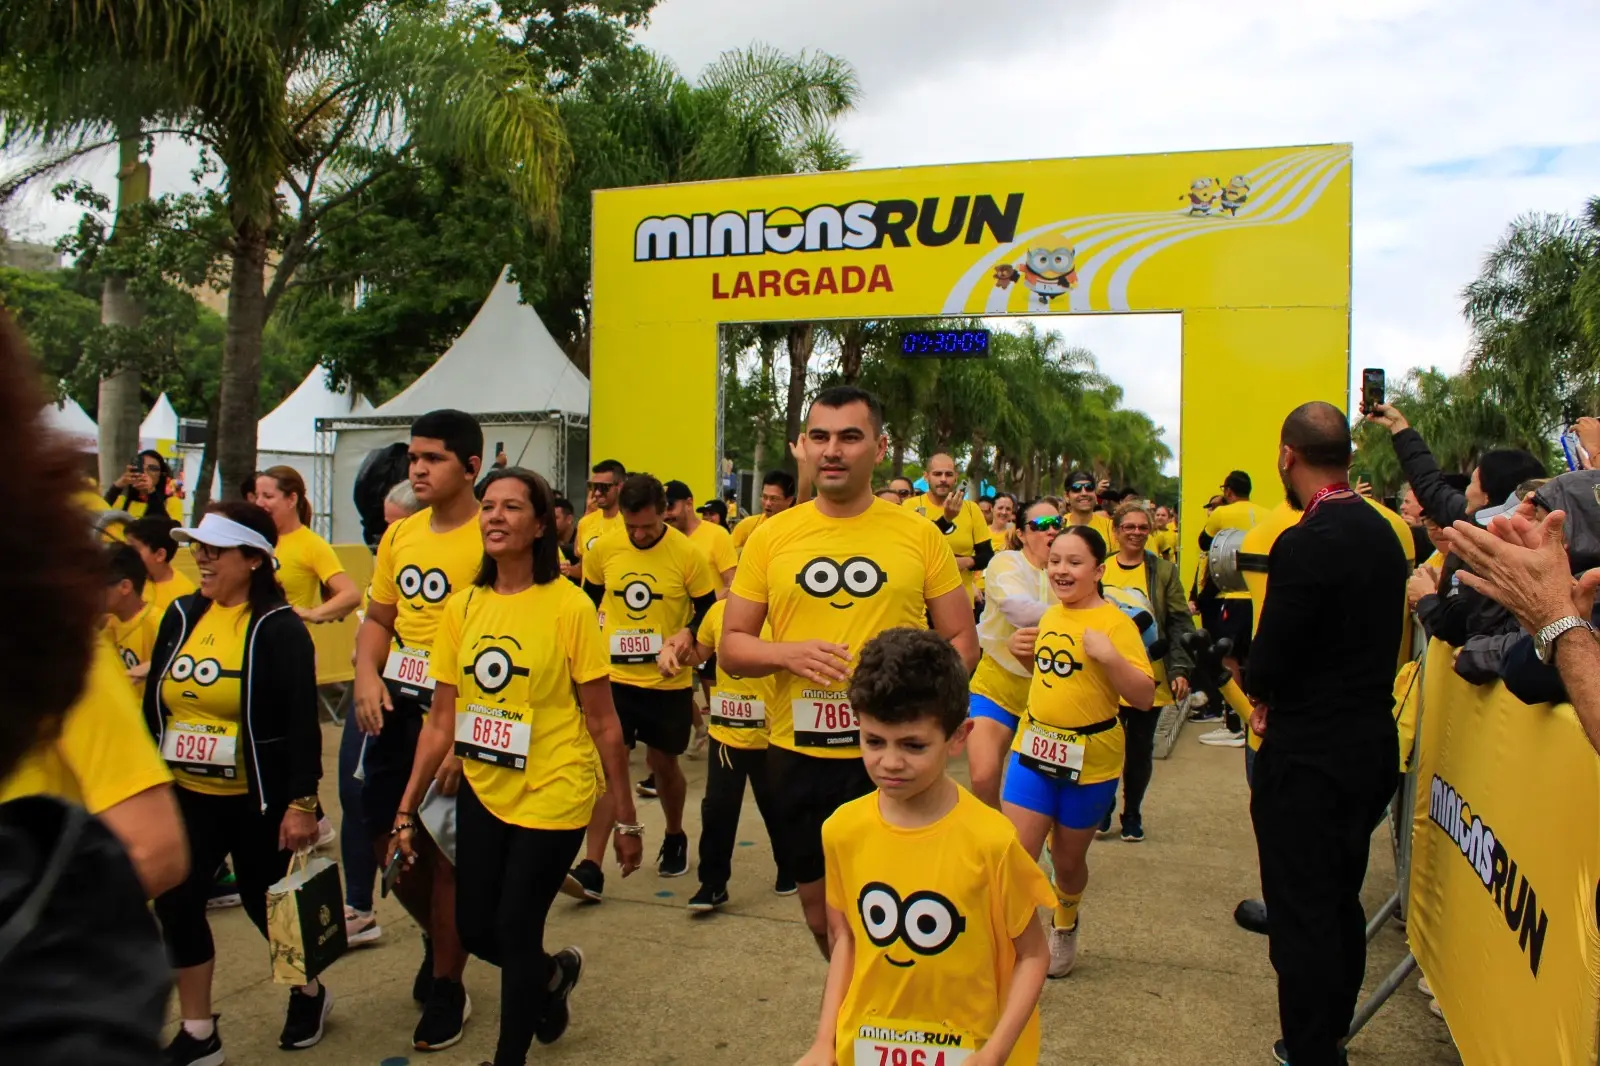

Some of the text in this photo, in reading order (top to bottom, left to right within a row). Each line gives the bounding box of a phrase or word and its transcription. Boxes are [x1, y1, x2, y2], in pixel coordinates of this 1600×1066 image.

[712, 264, 894, 300] LARGADA
[620, 636, 650, 653] 6950
[721, 699, 752, 718] 6949
[472, 716, 513, 749] 6835
[175, 734, 218, 761] 6297
[1032, 736, 1068, 764] 6243
